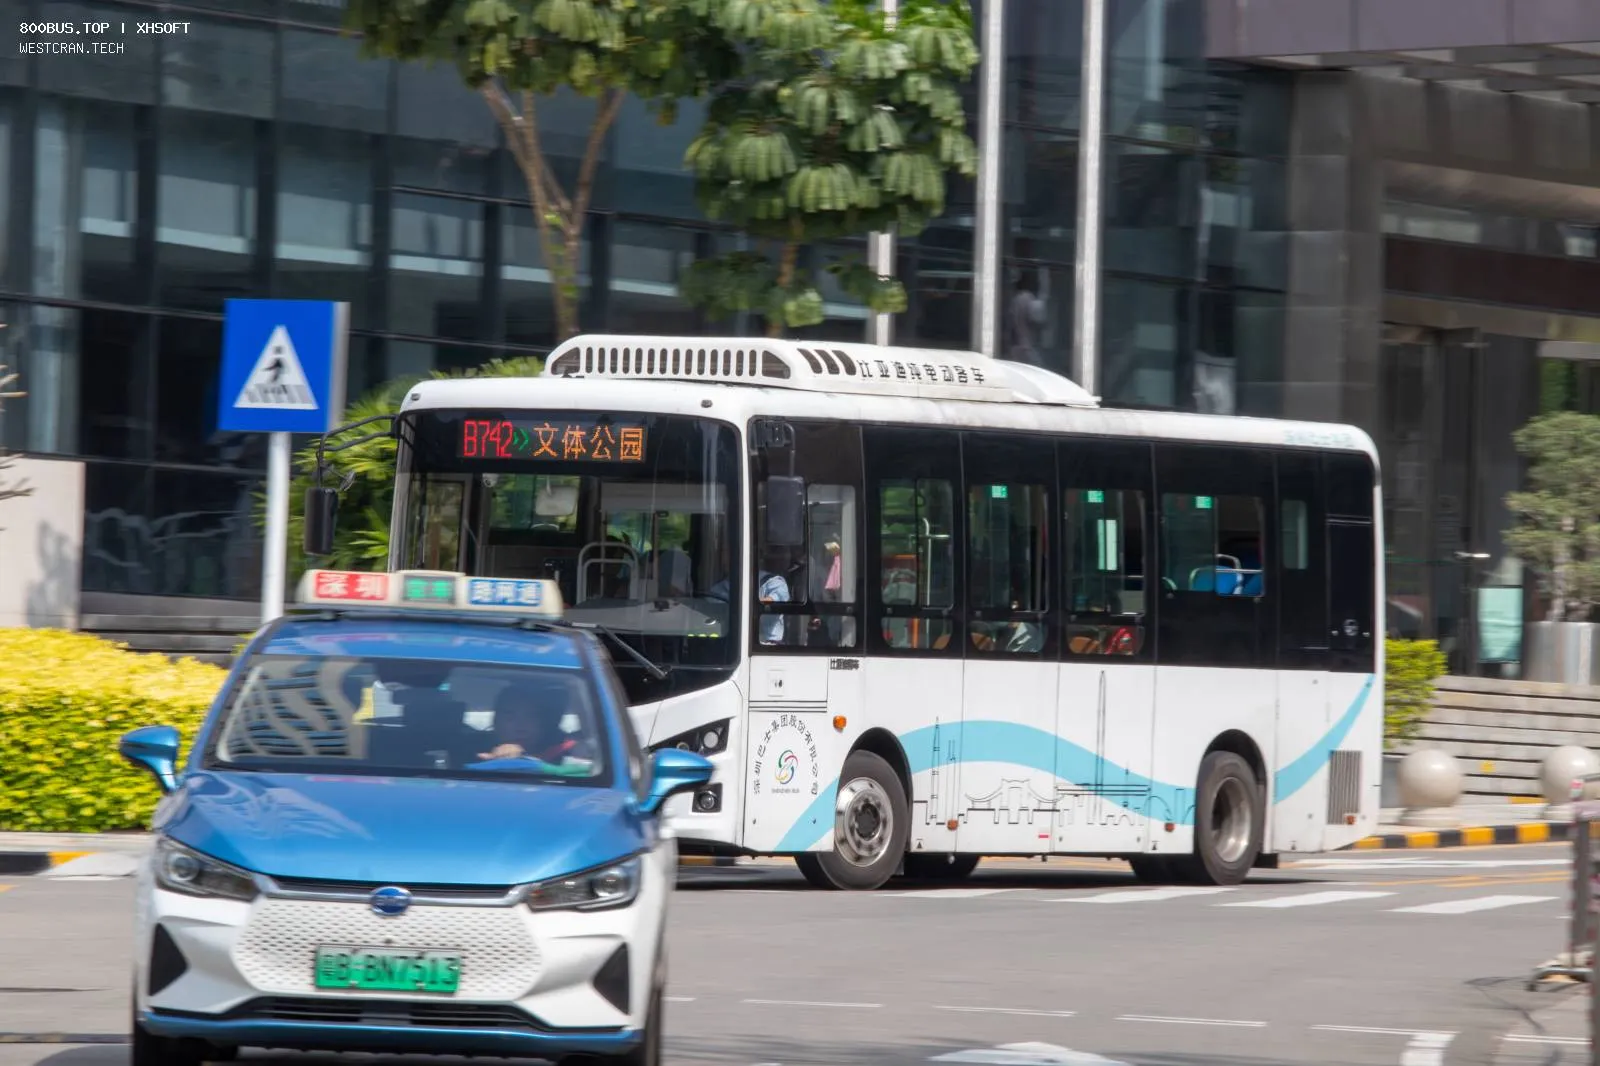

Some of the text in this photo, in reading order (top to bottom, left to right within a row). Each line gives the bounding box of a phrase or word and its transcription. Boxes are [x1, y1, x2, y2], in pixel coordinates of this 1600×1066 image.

[463, 420, 644, 461] B742 文体公园
